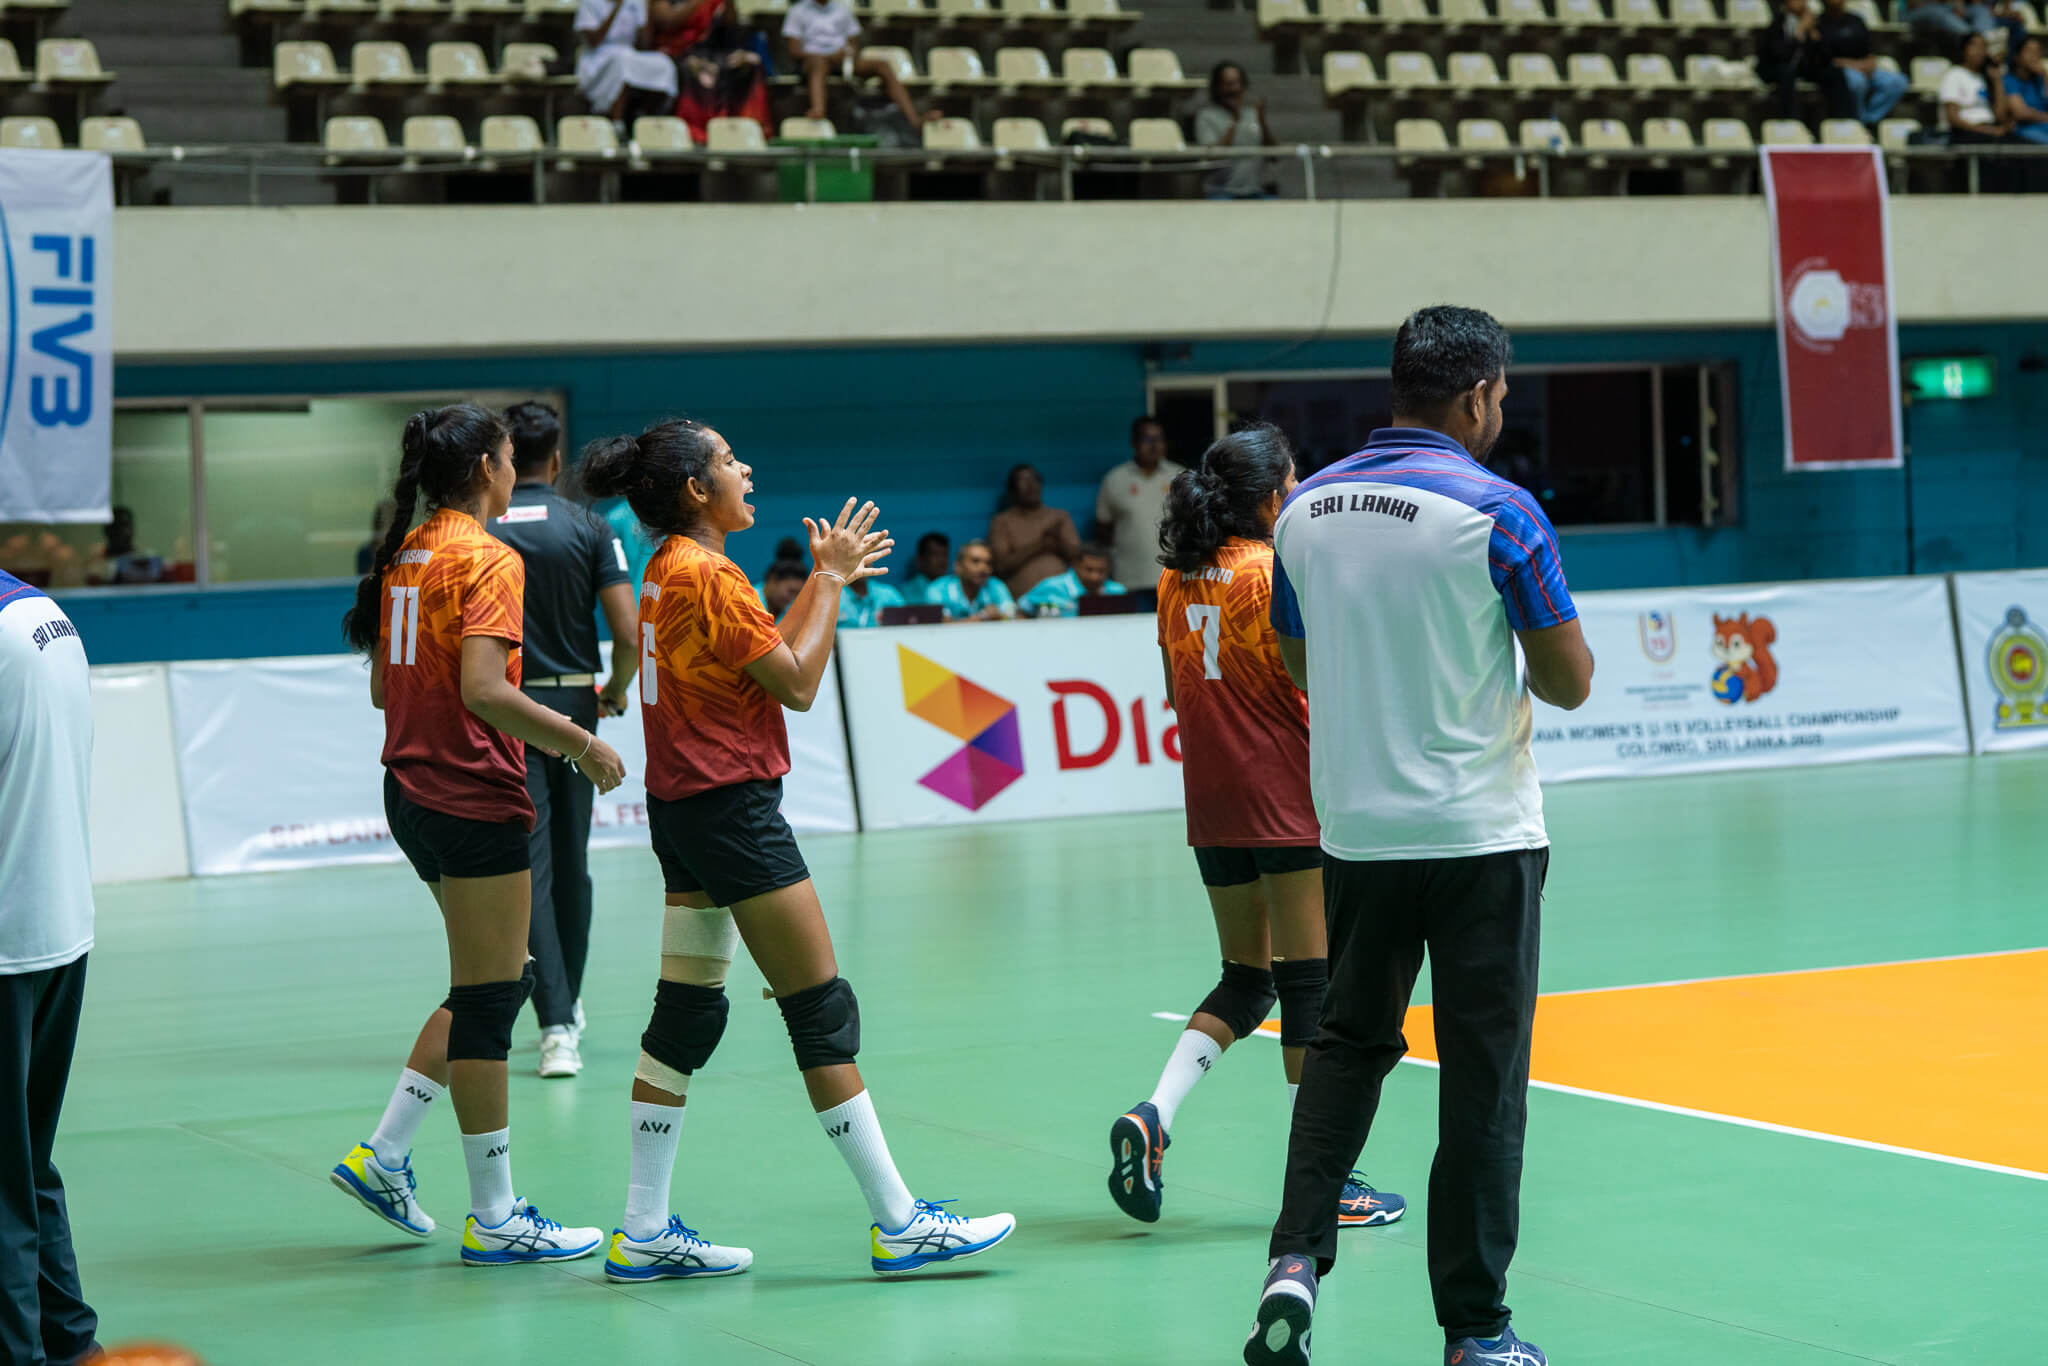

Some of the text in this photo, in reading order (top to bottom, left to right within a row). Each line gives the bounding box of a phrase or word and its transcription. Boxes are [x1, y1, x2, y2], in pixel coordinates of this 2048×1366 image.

[31, 235, 94, 428] FIVB
[1310, 494, 1420, 523] SRI LANKA
[32, 625, 51, 652] SRI
[390, 586, 419, 665] 11
[1186, 603, 1222, 680] 7
[1686, 714, 1783, 734] VOLLEYBALL
[1787, 707, 1899, 728] CHAMPIONSHIP
